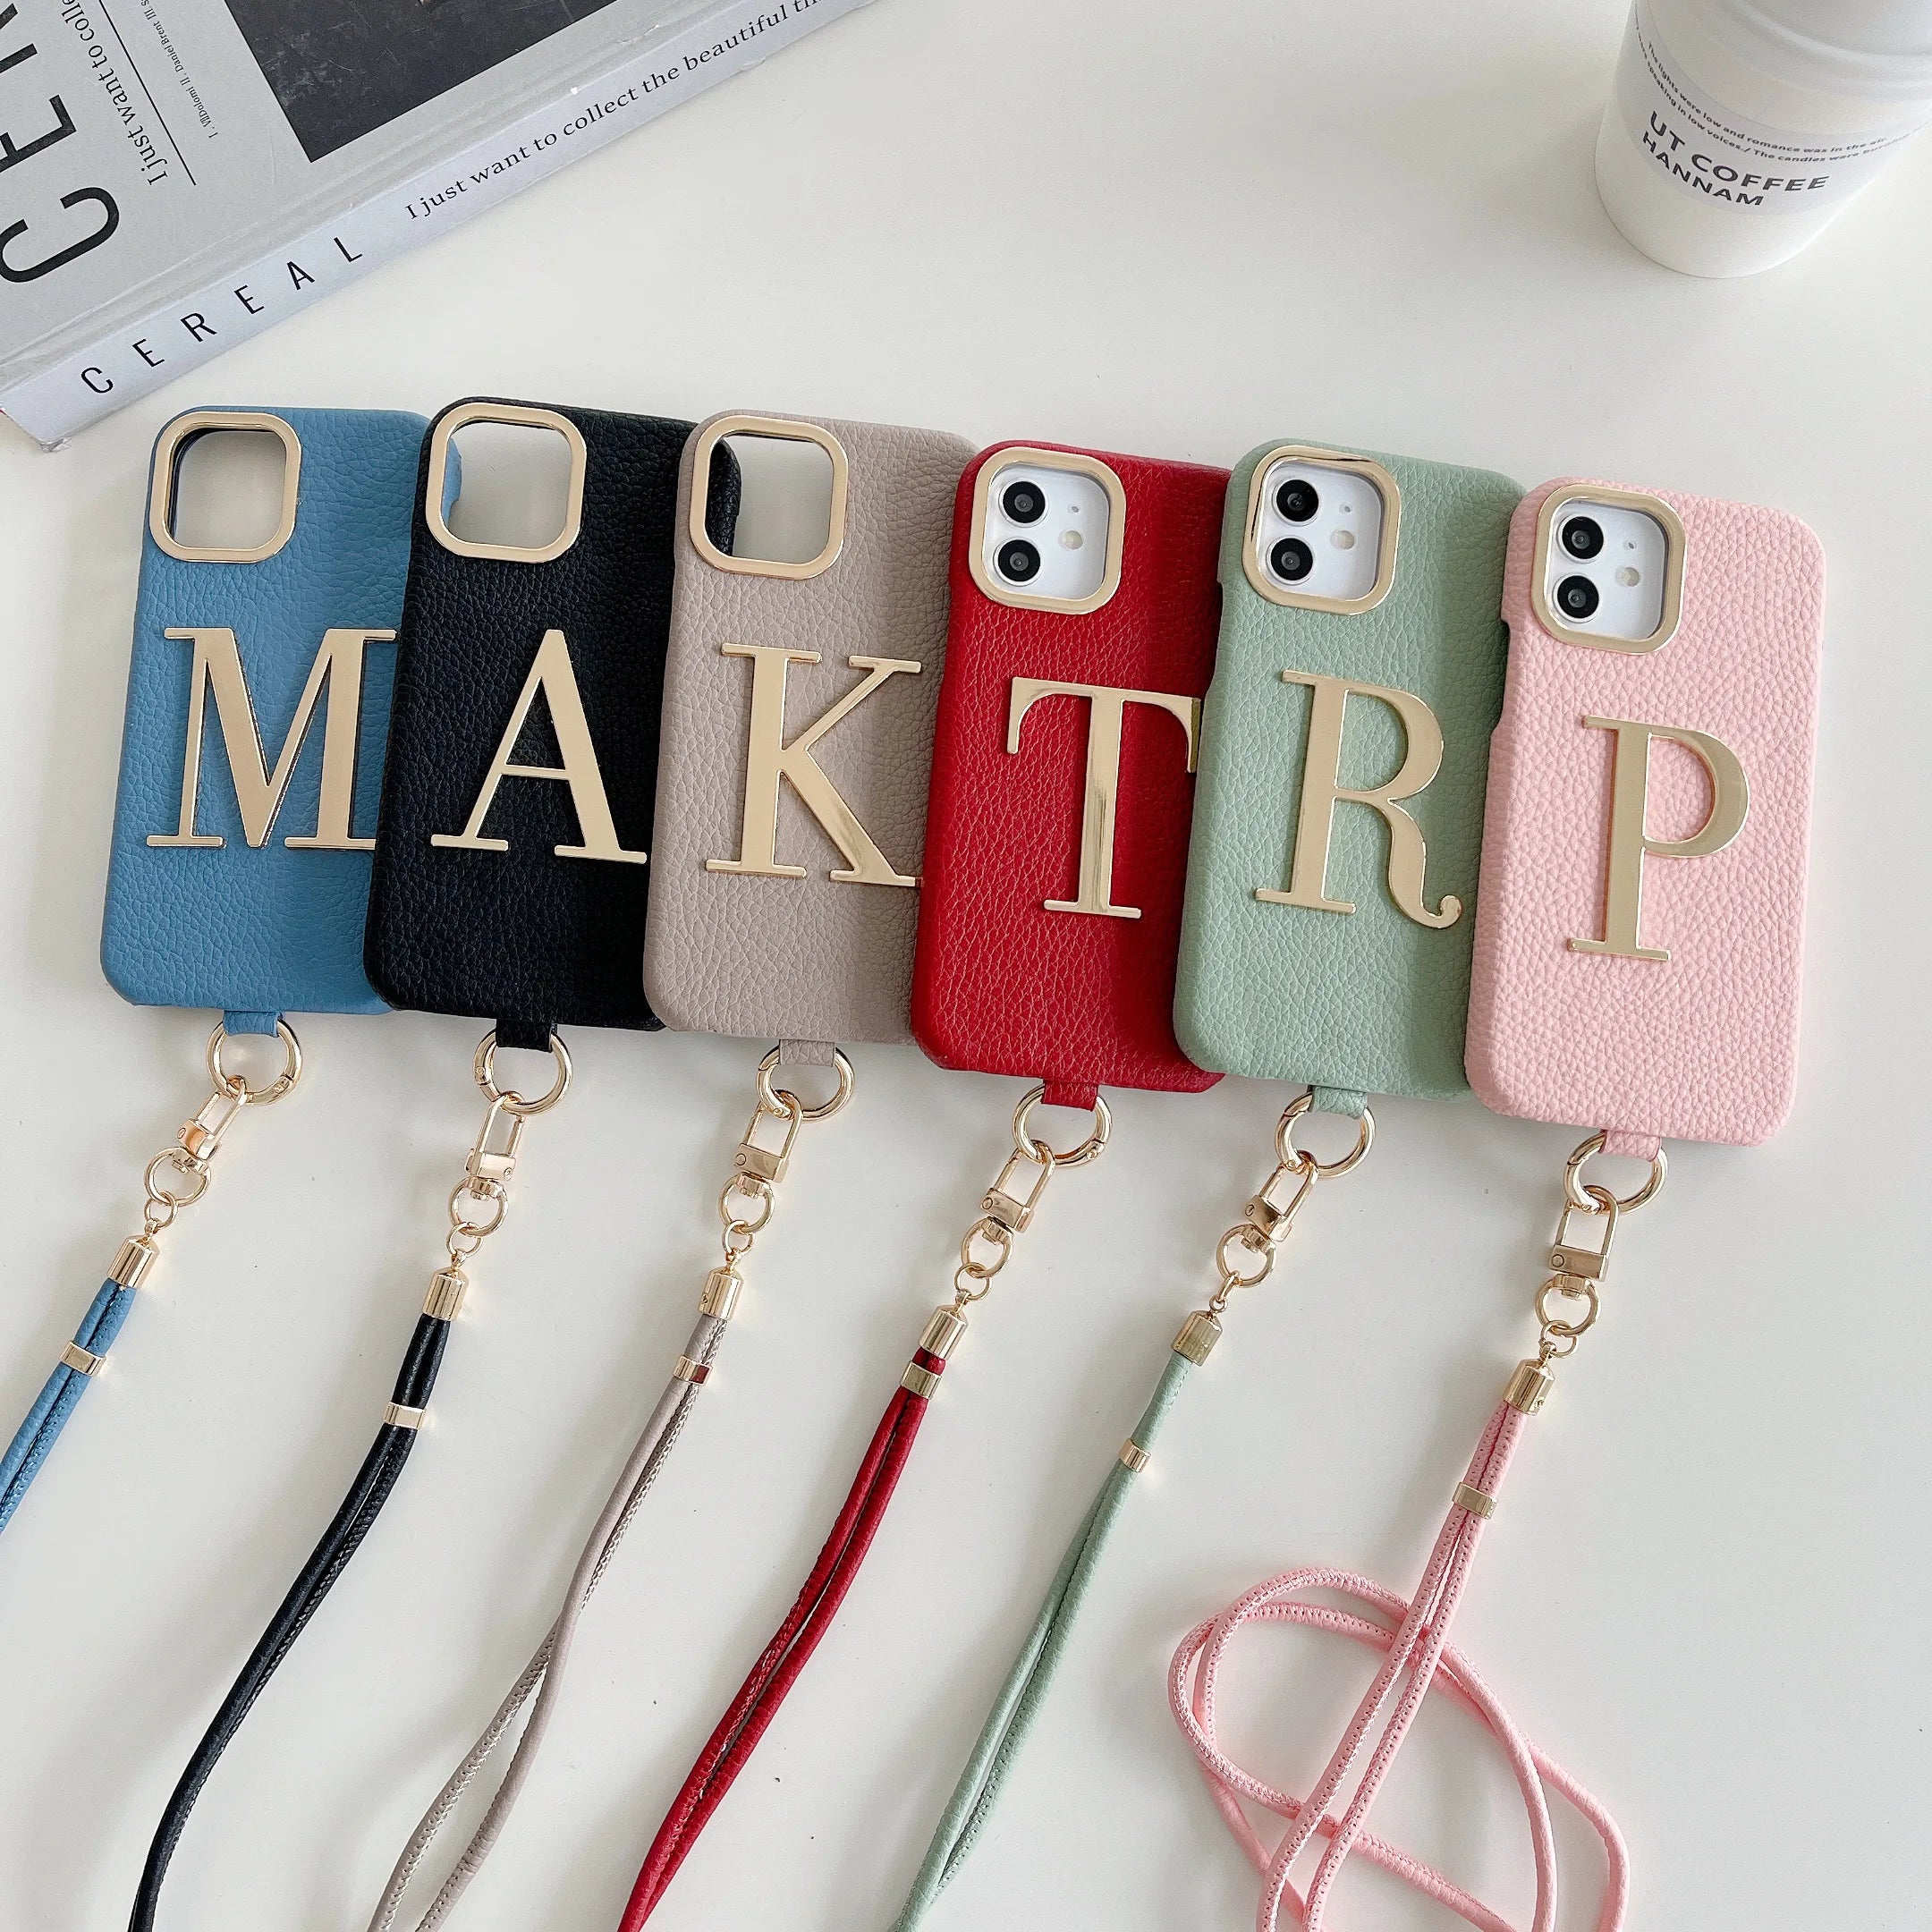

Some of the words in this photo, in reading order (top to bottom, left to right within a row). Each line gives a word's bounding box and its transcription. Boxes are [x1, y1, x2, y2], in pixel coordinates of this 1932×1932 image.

[88, 45, 107, 69] to
[153, 21, 170, 46] Brent
[164, 45, 184, 72] Daniel
[97, 68, 136, 125] want
[1658, 63, 1679, 93] lights
[1680, 93, 1701, 114] were
[1703, 113, 1722, 128] low
[1723, 127, 1745, 140] and
[1747, 137, 1801, 152] romance
[1677, 105, 1686, 116] in
[1688, 114, 1705, 130] low
[1753, 148, 1775, 159] The
[127, 125, 167, 171] just
[148, 170, 168, 186] I
[1642, 131, 1764, 206] HANNAM
[1650, 110, 1685, 151] UT
[1691, 154, 1831, 191] COFFEE
[80, 237, 362, 394] CEREAL
[405, 204, 419, 220] I
[419, 180, 468, 217] just
[470, 147, 531, 184] want
[533, 133, 557, 151] to
[563, 88, 639, 136] collect
[641, 67, 681, 94] the
[682, 4, 789, 71] beautiful
[146, 627, 397, 849] M
[430, 629, 648, 864] A
[705, 642, 923, 888] K
[1005, 675, 1201, 919] T
[1255, 669, 1462, 928] R
[1568, 715, 1750, 961] P
